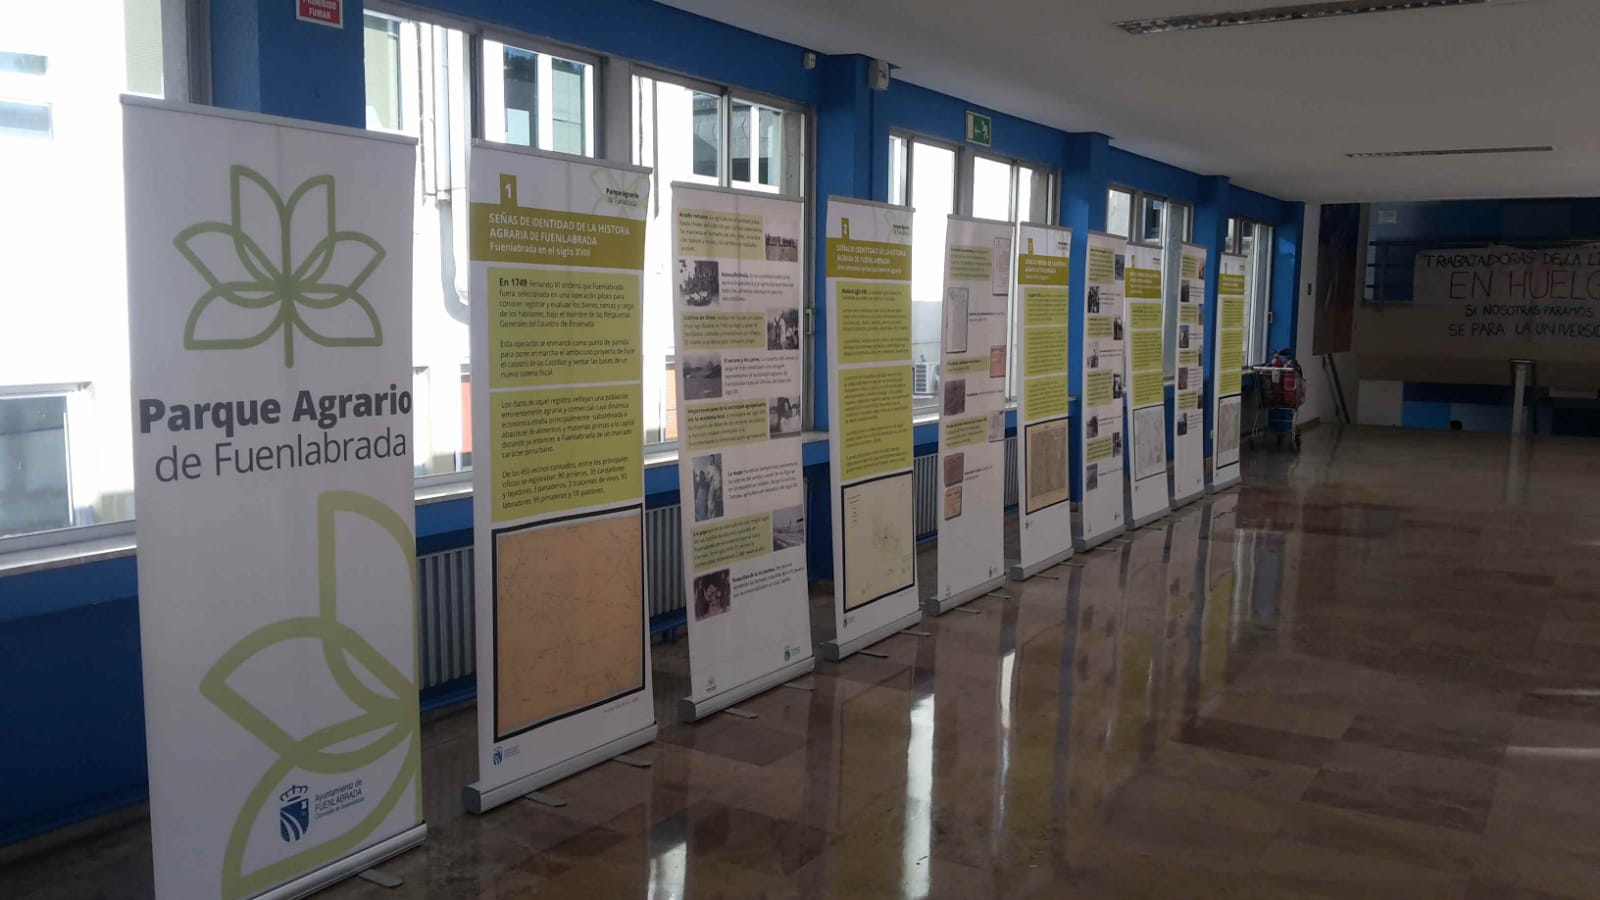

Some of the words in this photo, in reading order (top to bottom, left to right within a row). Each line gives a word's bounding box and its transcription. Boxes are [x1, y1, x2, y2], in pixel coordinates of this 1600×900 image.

[505, 183, 512, 198] 1
[489, 212, 518, 224] SEÑAS
[520, 216, 530, 226] DE
[532, 218, 574, 230] IDENTIDAD
[577, 222, 586, 232] DE
[587, 223, 596, 232] LA
[599, 224, 630, 235] HISTORIA
[490, 228, 528, 240] AGRARIA
[530, 231, 539, 241] DE
[541, 232, 597, 245] FUENLABRADA
[490, 242, 537, 254] Fuenlabrada
[538, 246, 547, 254] en
[548, 244, 555, 254] el
[556, 245, 574, 258] siglo
[1424, 251, 1536, 268] TRABAJADORAS
[1544, 252, 1561, 266] DE
[1563, 252, 1580, 266] LA
[500, 277, 509, 286] En
[512, 278, 527, 287] 1749
[1449, 271, 1494, 299] EN
[1464, 304, 1477, 317] SI
[1482, 304, 1540, 317] NOSOTRAS
[1544, 305, 1594, 318] PARAMOS
[1448, 323, 1465, 336] SE
[1472, 322, 1504, 336] PARA
[1515, 322, 1532, 336] LA
[138, 398, 281, 438] Parque
[292, 384, 412, 429] Agrario
[155, 445, 201, 483] de
[215, 426, 406, 476] Fuenlabrada
[315, 787, 362, 811] FUENLABRADA
